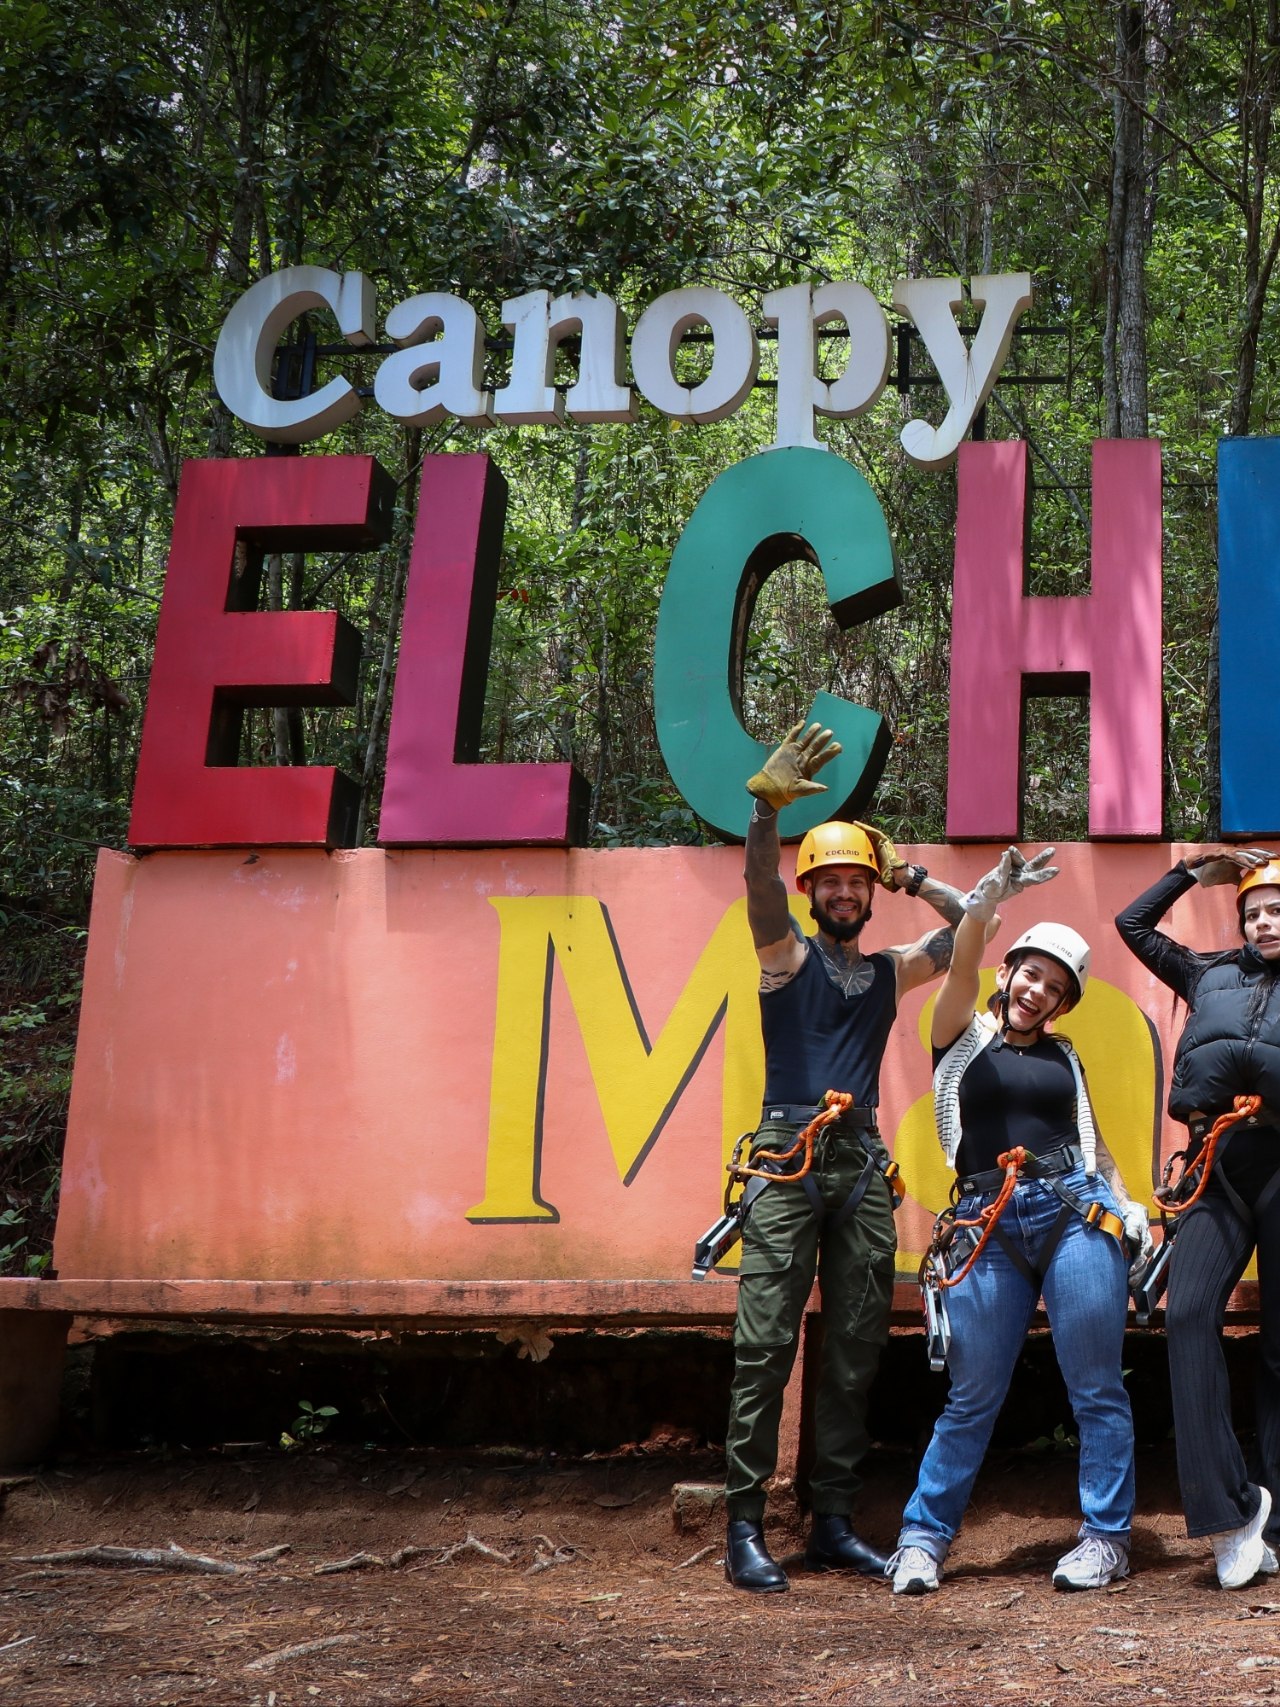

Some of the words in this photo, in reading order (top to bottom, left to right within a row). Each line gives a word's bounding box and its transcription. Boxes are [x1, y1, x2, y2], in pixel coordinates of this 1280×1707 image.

[213, 263, 1033, 473] Canopy
[127, 453, 593, 850] EL
[825, 849, 860, 857] EDELRID
[1046, 940, 1073, 959] ELRID
